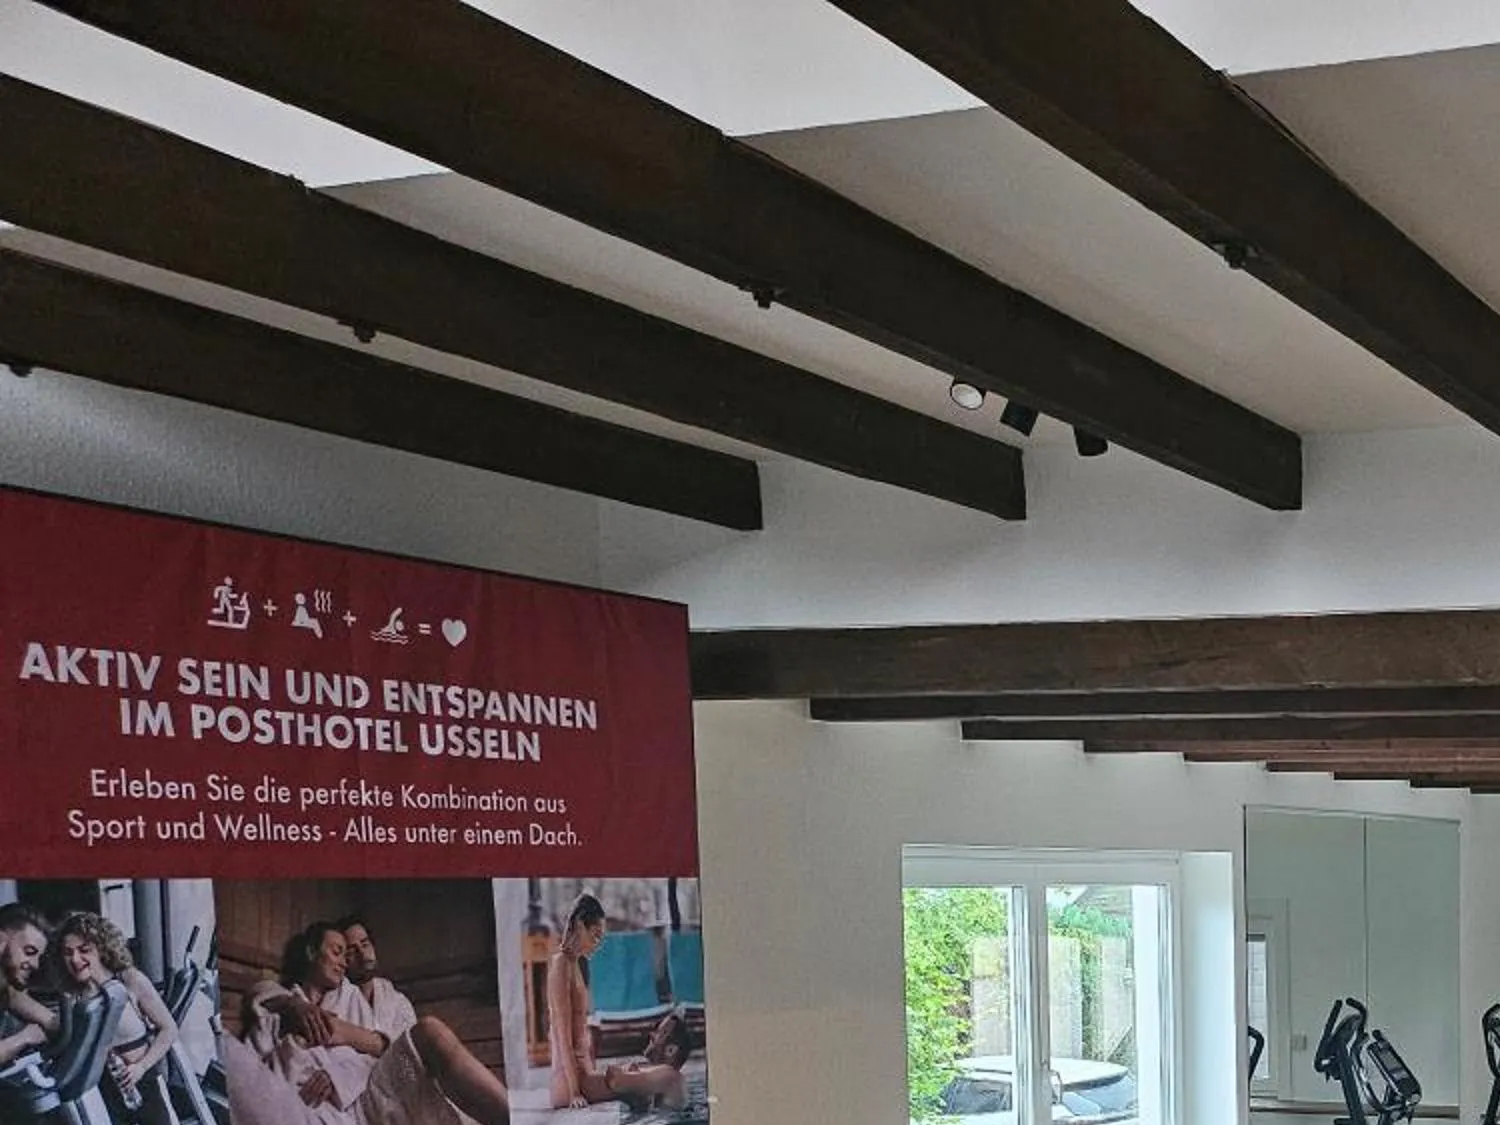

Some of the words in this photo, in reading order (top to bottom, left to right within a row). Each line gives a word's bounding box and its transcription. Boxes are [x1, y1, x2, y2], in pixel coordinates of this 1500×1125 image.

[19, 642, 161, 691] AKTIV
[177, 657, 270, 701] SEIN
[285, 668, 370, 709] UND
[382, 678, 598, 730] ENTSPANNEN
[119, 697, 175, 737] IM
[190, 703, 408, 753] POSTHOTEL
[419, 720, 541, 762] USSELN
[90, 767, 196, 800] Erleben
[207, 773, 245, 802] Sie
[254, 775, 291, 803] die
[300, 778, 394, 811] perfekte
[401, 783, 528, 812] Kombination
[533, 797, 567, 813] aus
[67, 809, 146, 846] Sport
[156, 811, 205, 840] und
[213, 813, 322, 842] Wellness
[344, 815, 397, 843] Alles
[405, 822, 457, 844] unter
[463, 821, 523, 845] einem
[529, 822, 583, 846] Dach.
